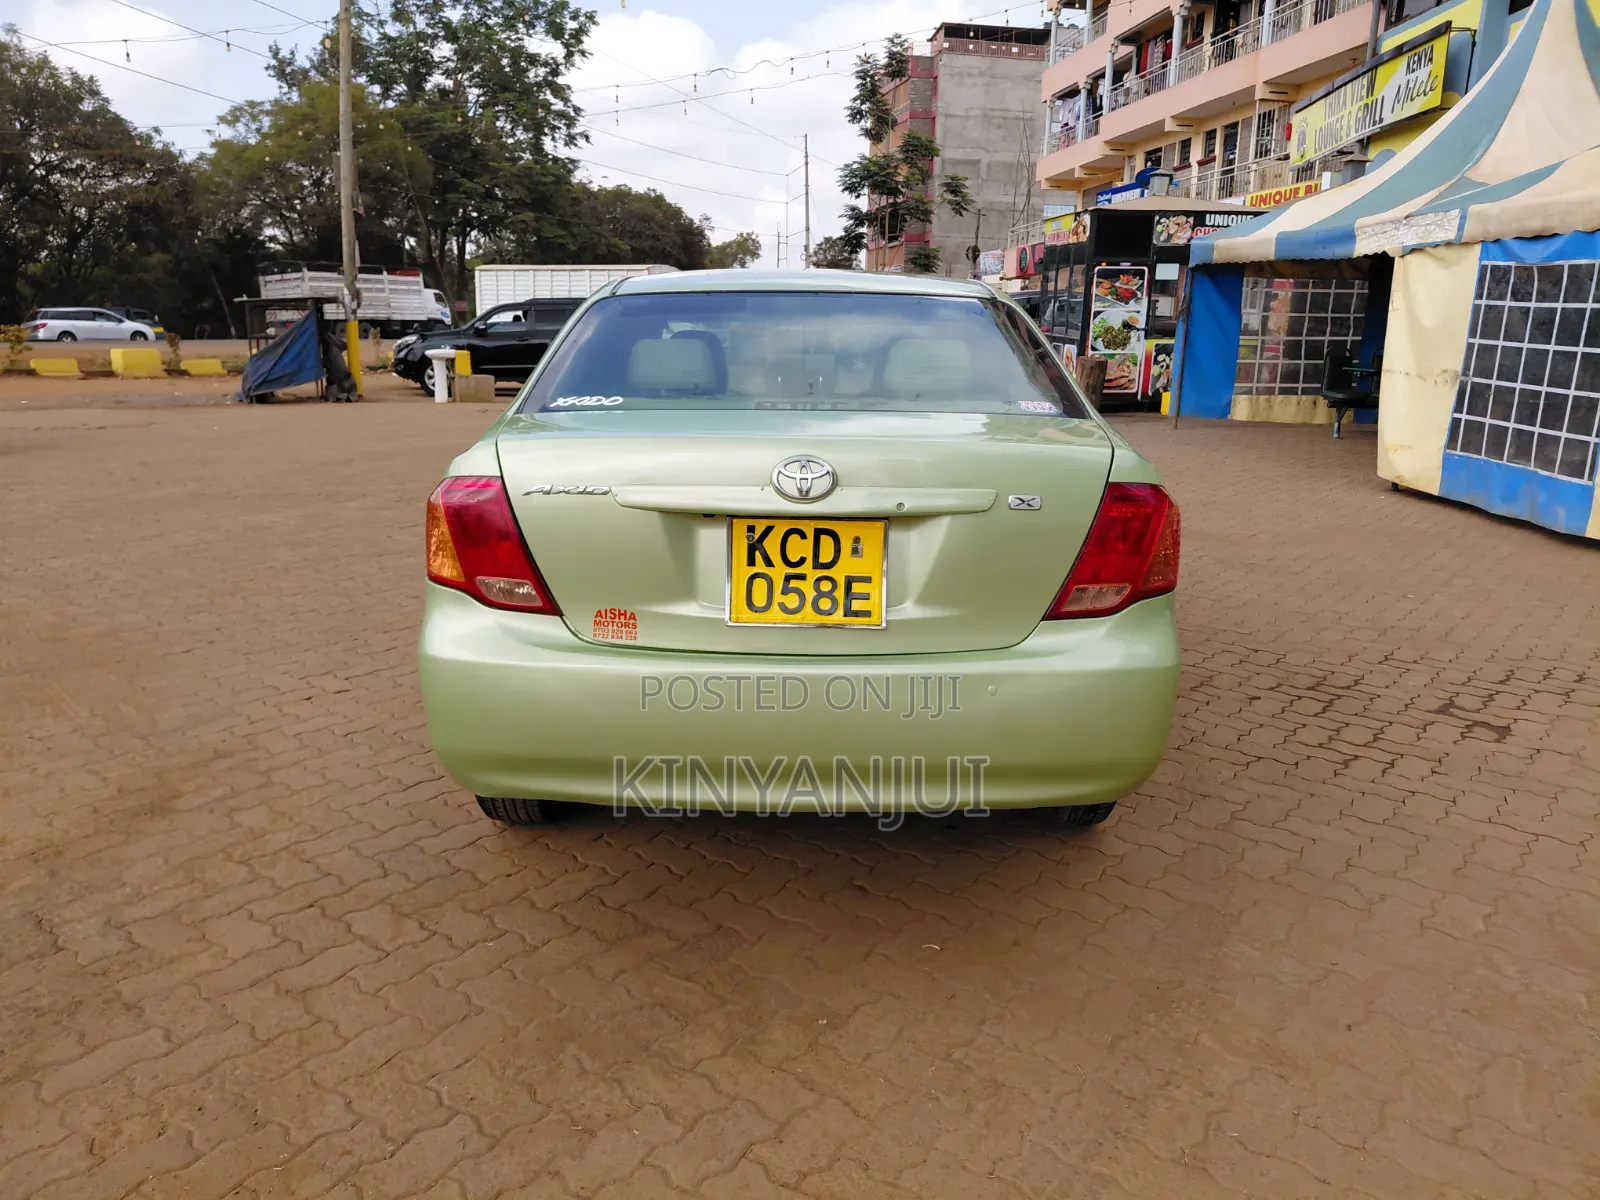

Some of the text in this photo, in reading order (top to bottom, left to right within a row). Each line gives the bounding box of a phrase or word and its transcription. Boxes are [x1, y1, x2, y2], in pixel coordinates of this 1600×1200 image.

[1405, 44, 1434, 76] KENYA
[1324, 67, 1378, 121] THIKA VIEW
[1391, 69, 1440, 114] Milele
[1313, 94, 1385, 154] LOUNGE & GRILL
[1249, 187, 1301, 207] UNIQUE
[549, 395, 624, 408] XADO
[1012, 496, 1037, 508] X
[746, 524, 841, 570] KCD
[745, 571, 872, 618] 058E
[593, 607, 638, 622] AISHA
[593, 619, 638, 630] MOTORS
